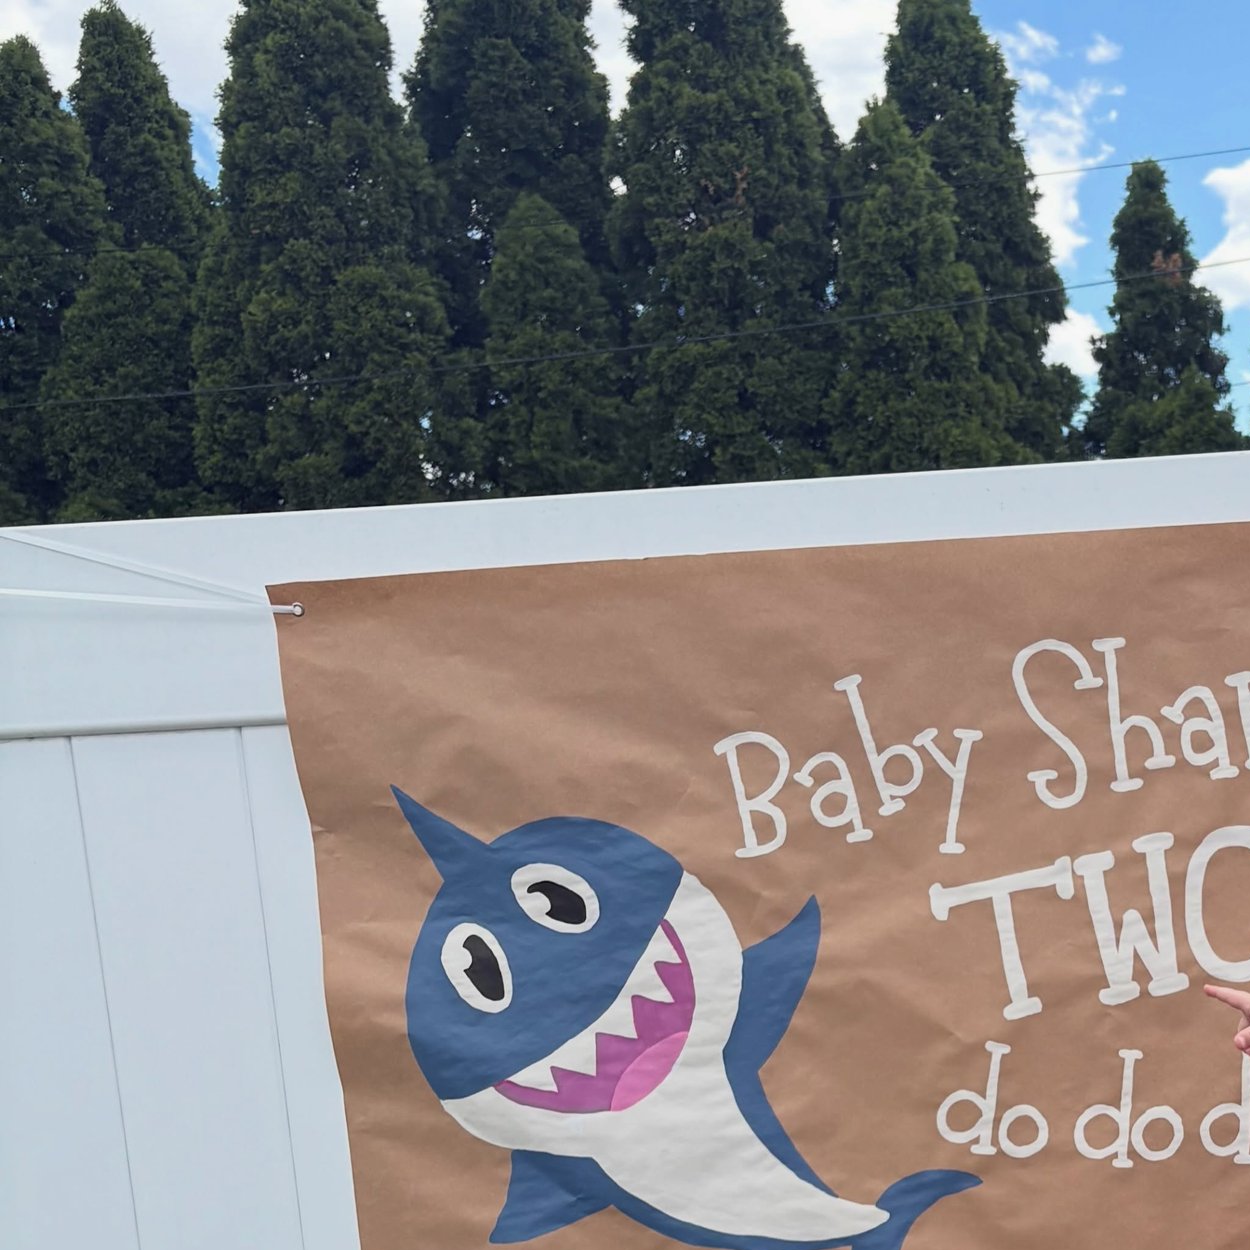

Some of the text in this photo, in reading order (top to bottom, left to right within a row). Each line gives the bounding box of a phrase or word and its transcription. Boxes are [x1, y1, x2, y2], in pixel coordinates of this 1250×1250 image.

[713, 673, 984, 858] Baby
[935, 1039, 1049, 1159] do
[1073, 1048, 1184, 1168] do
